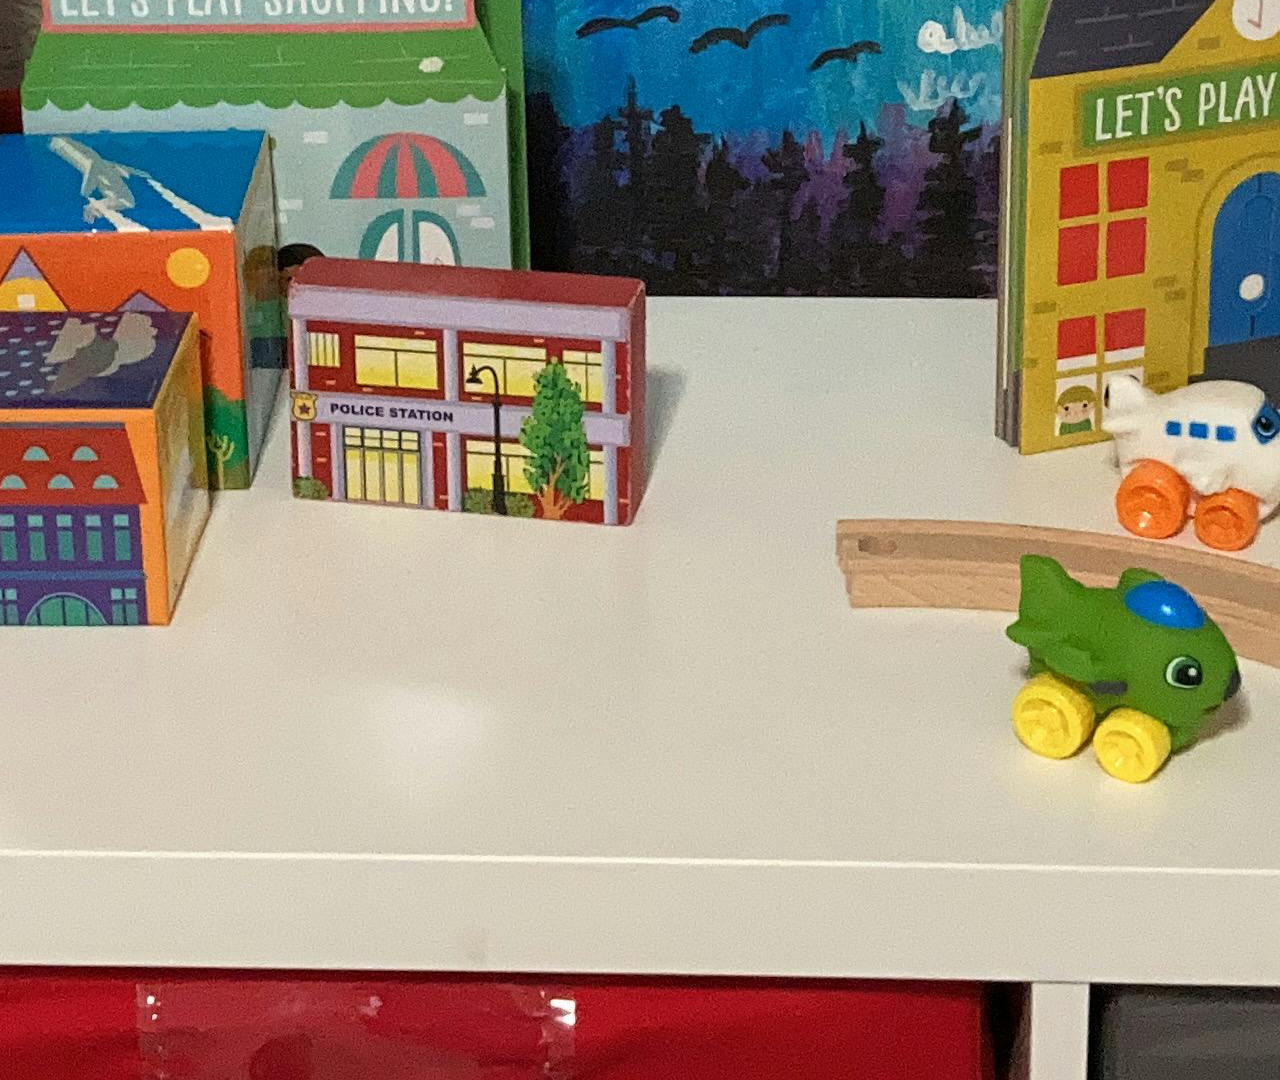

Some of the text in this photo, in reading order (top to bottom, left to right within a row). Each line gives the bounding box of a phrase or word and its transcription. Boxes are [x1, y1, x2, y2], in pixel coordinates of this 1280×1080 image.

[1094, 84, 1183, 142] LET'S
[1197, 71, 1278, 127] PLAY
[329, 403, 454, 423] POLICE STATION
